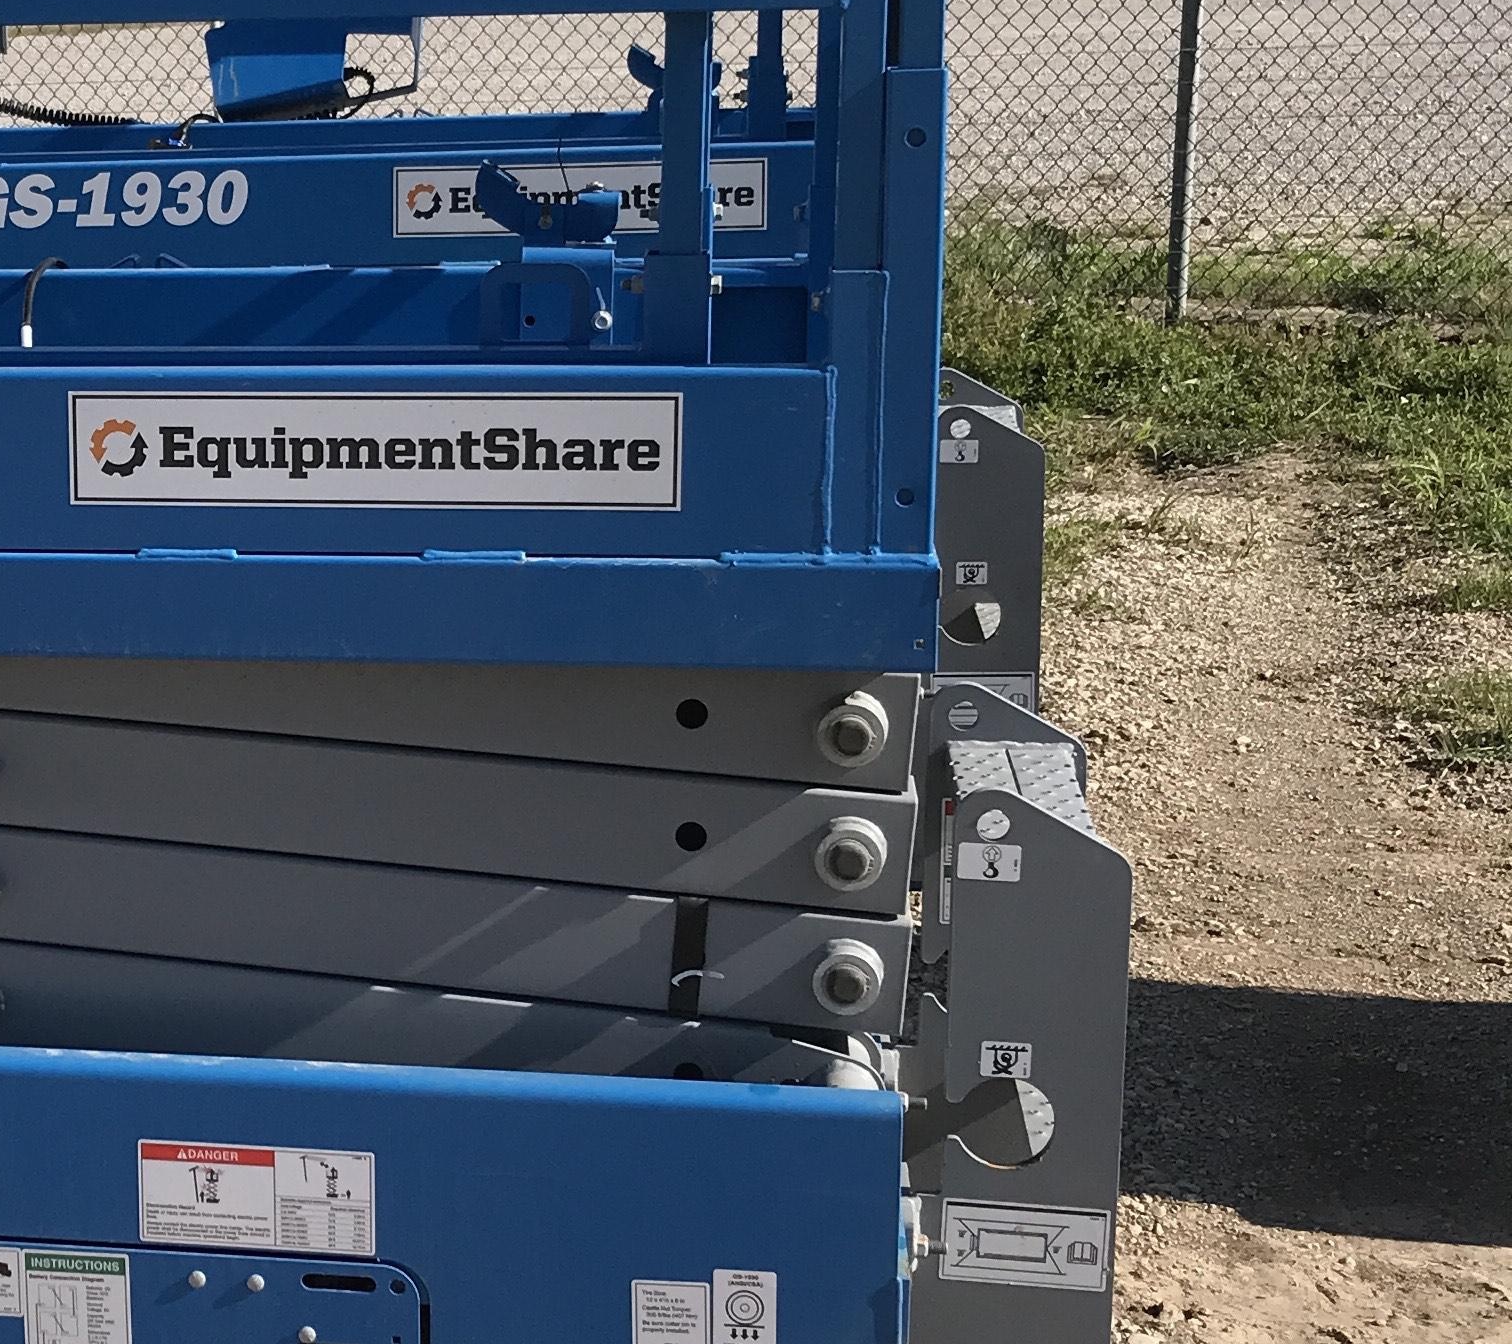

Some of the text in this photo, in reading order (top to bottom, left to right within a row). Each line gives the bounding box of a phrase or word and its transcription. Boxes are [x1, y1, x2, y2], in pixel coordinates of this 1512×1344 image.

[159, 425, 660, 478] EquipmentShare
[188, 1148, 238, 1161] DANGER
[31, 1257, 120, 1272] INSTRUCTIONS
